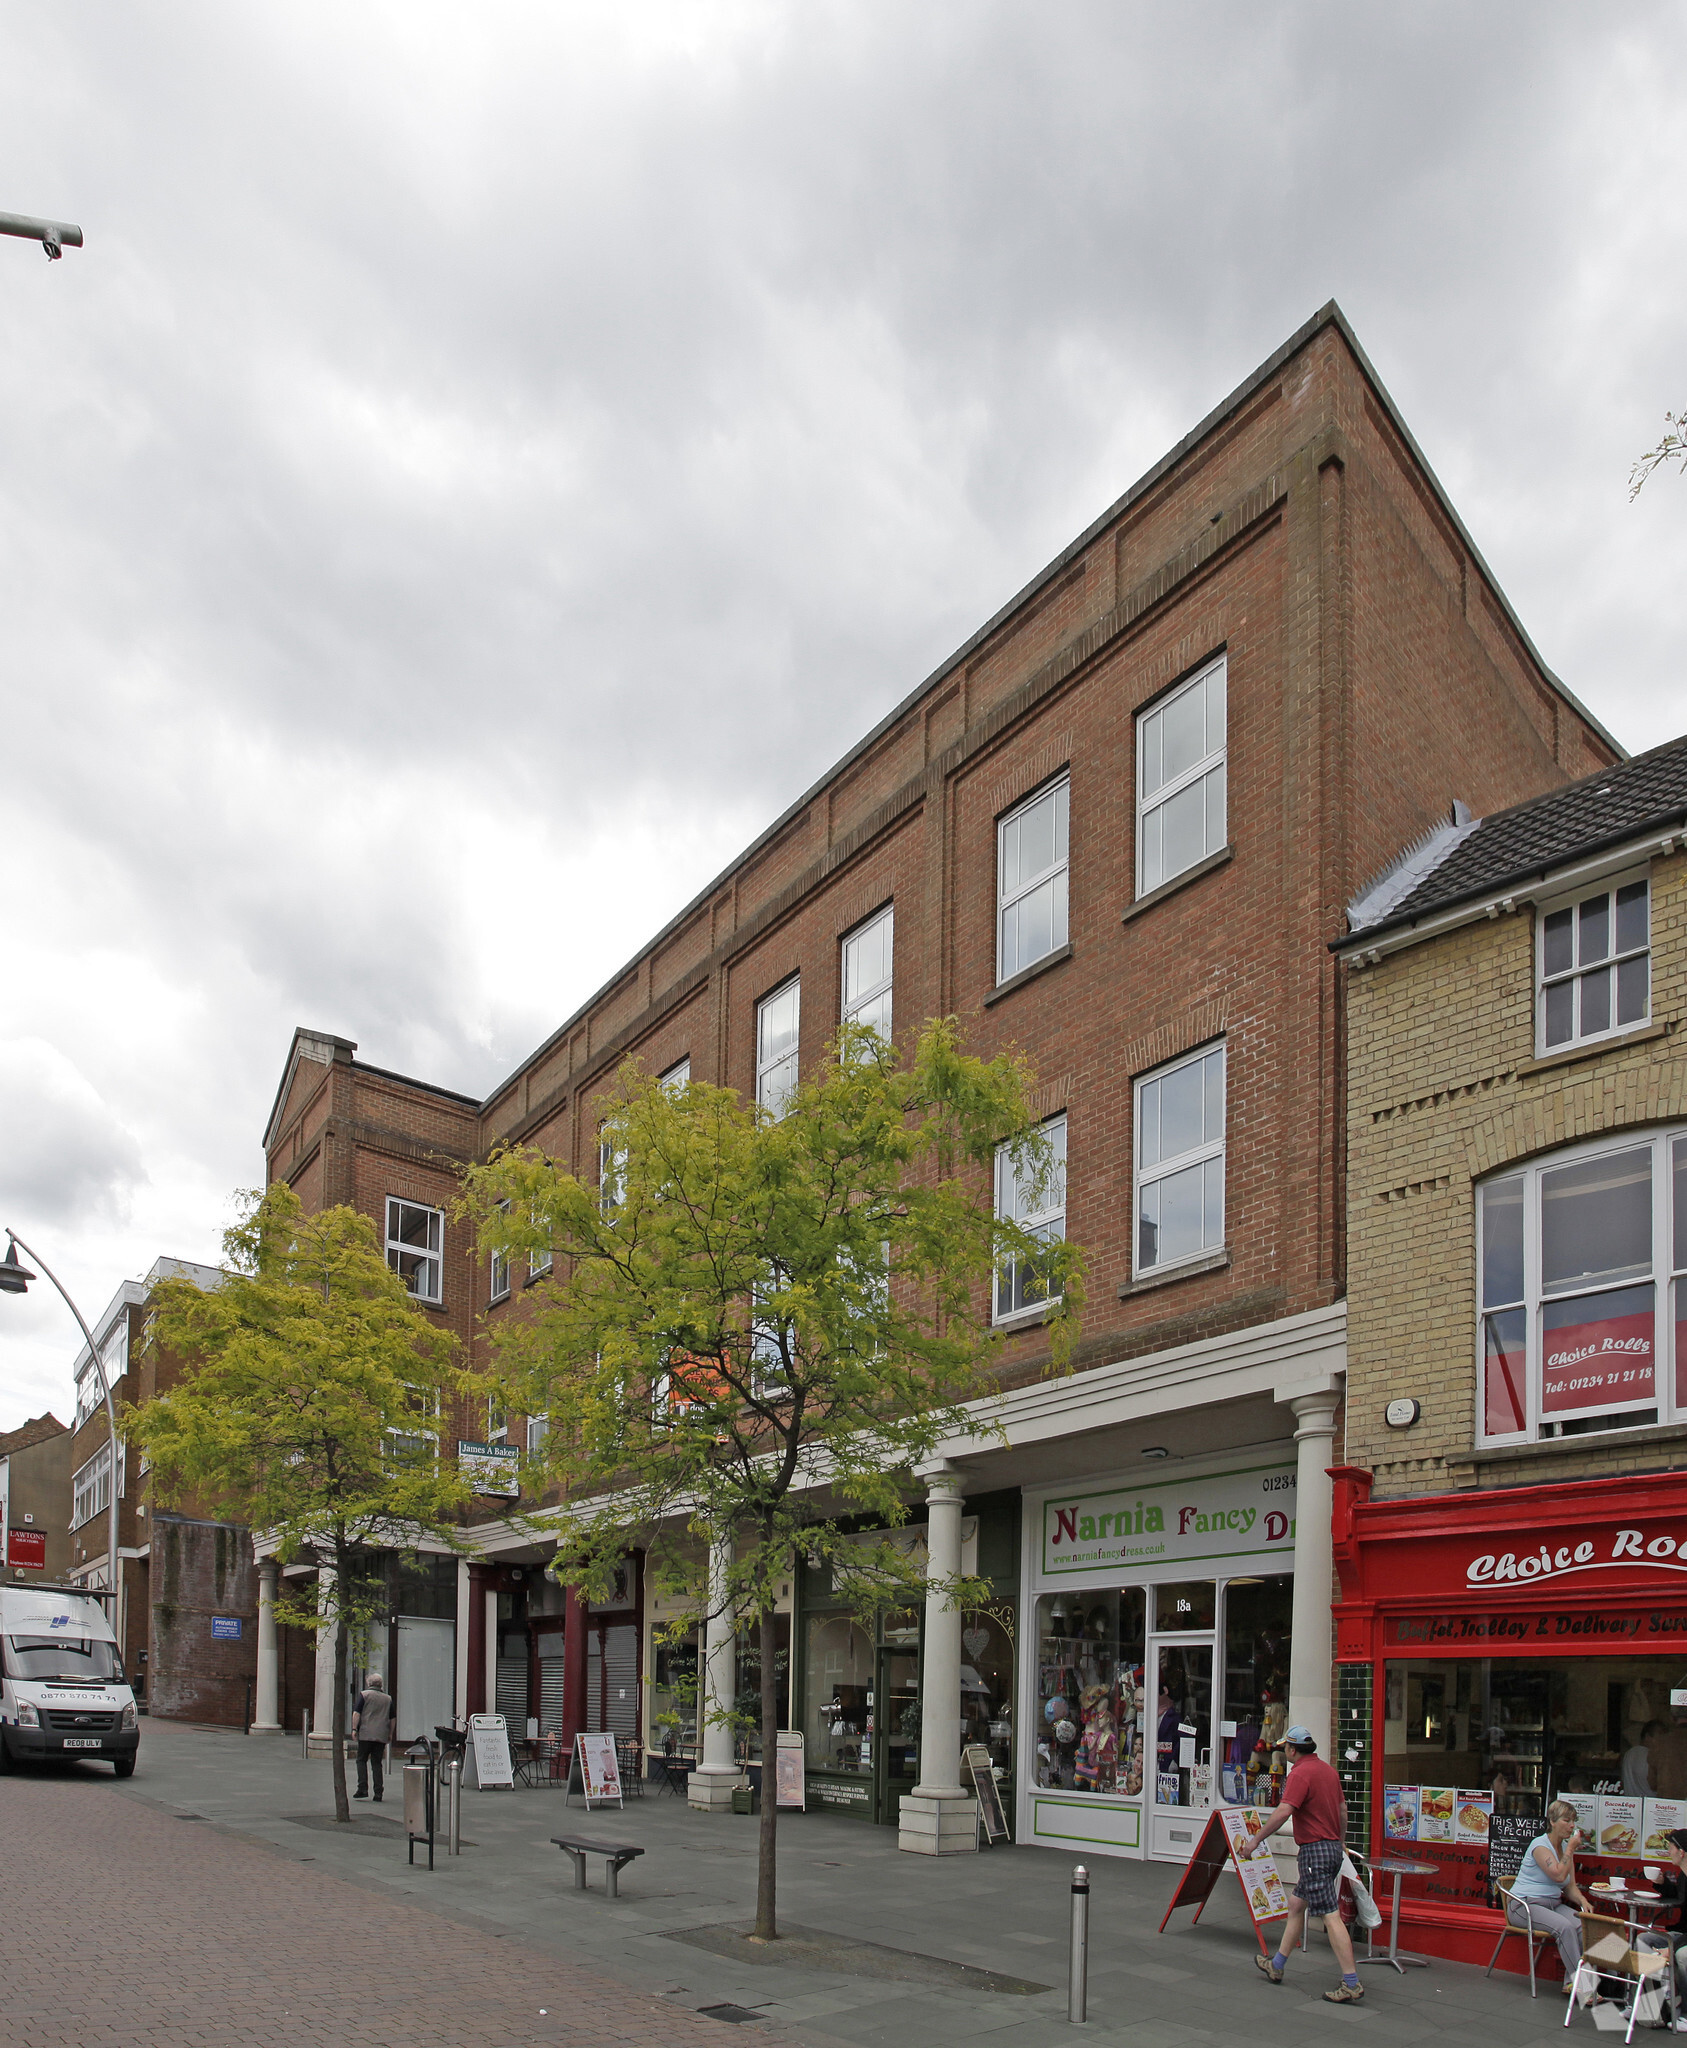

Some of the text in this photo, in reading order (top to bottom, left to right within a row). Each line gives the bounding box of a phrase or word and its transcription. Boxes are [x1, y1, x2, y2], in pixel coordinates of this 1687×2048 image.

[1547, 1337, 1651, 1366] Choice Rolls
[1545, 1366, 1652, 1394] Tel: 01234 21 21 18
[462, 1444, 516, 1456] James A Baker
[1262, 1474, 1297, 1492] 01234
[1051, 1501, 1166, 1545] Narnia
[1177, 1506, 1257, 1536] Fancy
[10, 1530, 45, 1540] LAWTONS
[1053, 1542, 1166, 1564] www.narniafancydress.co.uk
[1466, 1540, 1595, 1582] Choice
[1176, 1599, 1192, 1612] 18a
[1536, 1617, 1550, 1636] &
[1555, 1615, 1642, 1637] Delivery
[1491, 1816, 1545, 1829] THIS WEEK
[1498, 1826, 1537, 1837] SPECIAL
